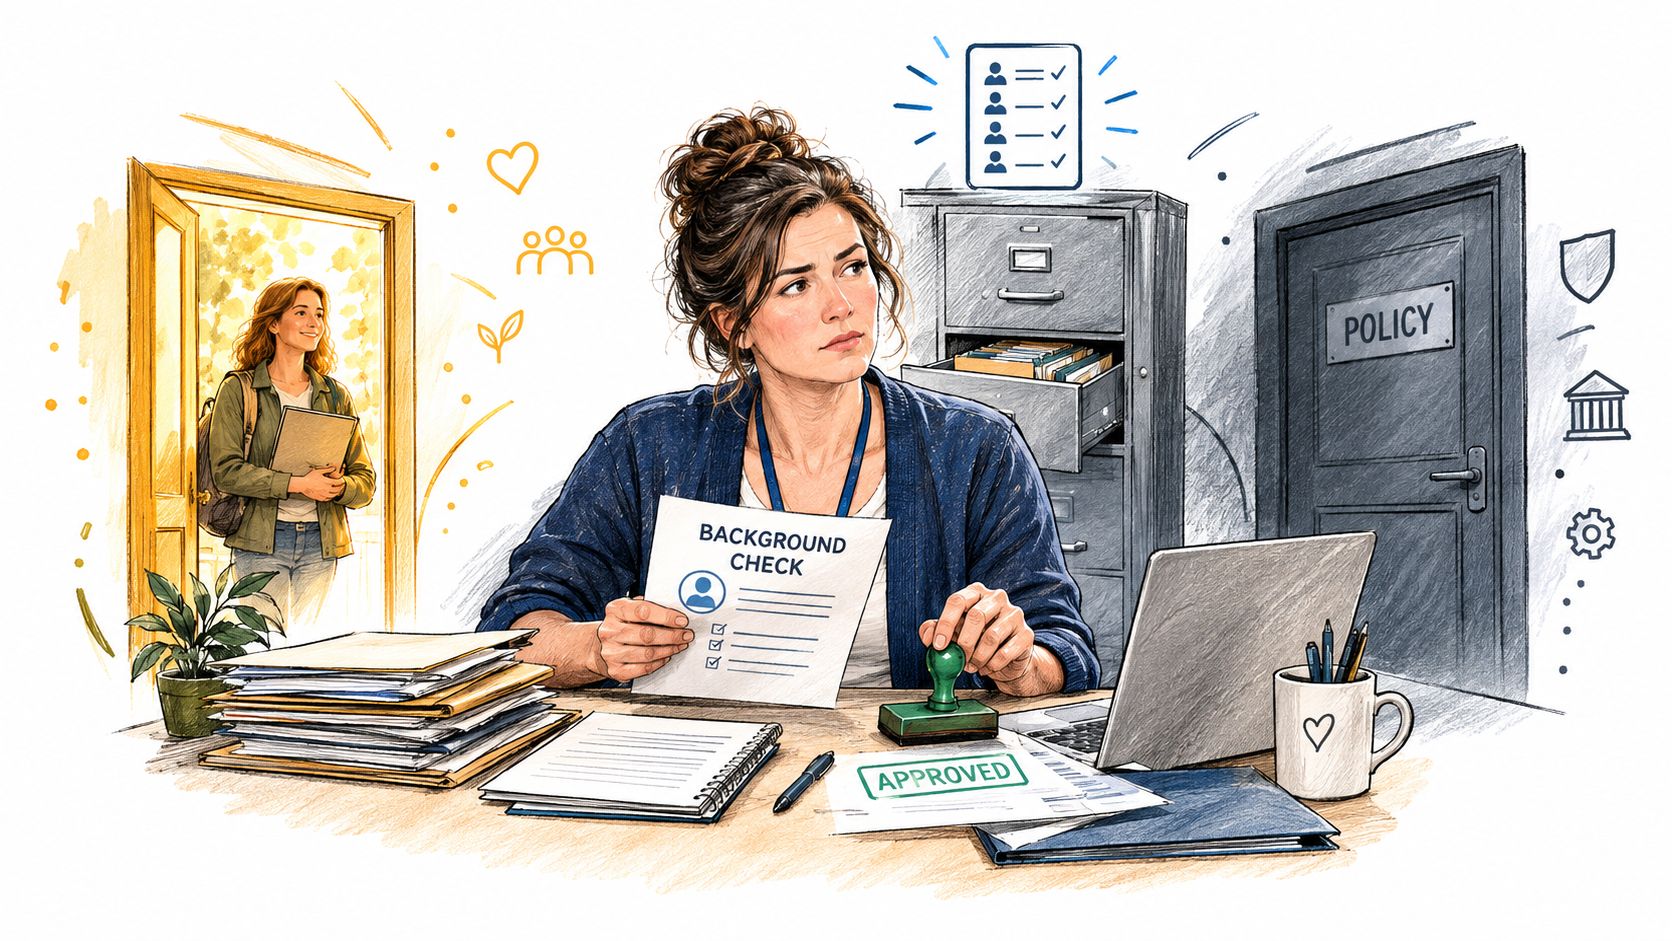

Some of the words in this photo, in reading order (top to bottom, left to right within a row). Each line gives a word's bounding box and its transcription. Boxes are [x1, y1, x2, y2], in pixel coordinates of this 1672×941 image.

[1345, 302, 1434, 347] POLICY
[699, 523, 847, 554] BACKGROUND
[730, 553, 804, 576] CHECK
[878, 762, 1011, 791] APPROVED
